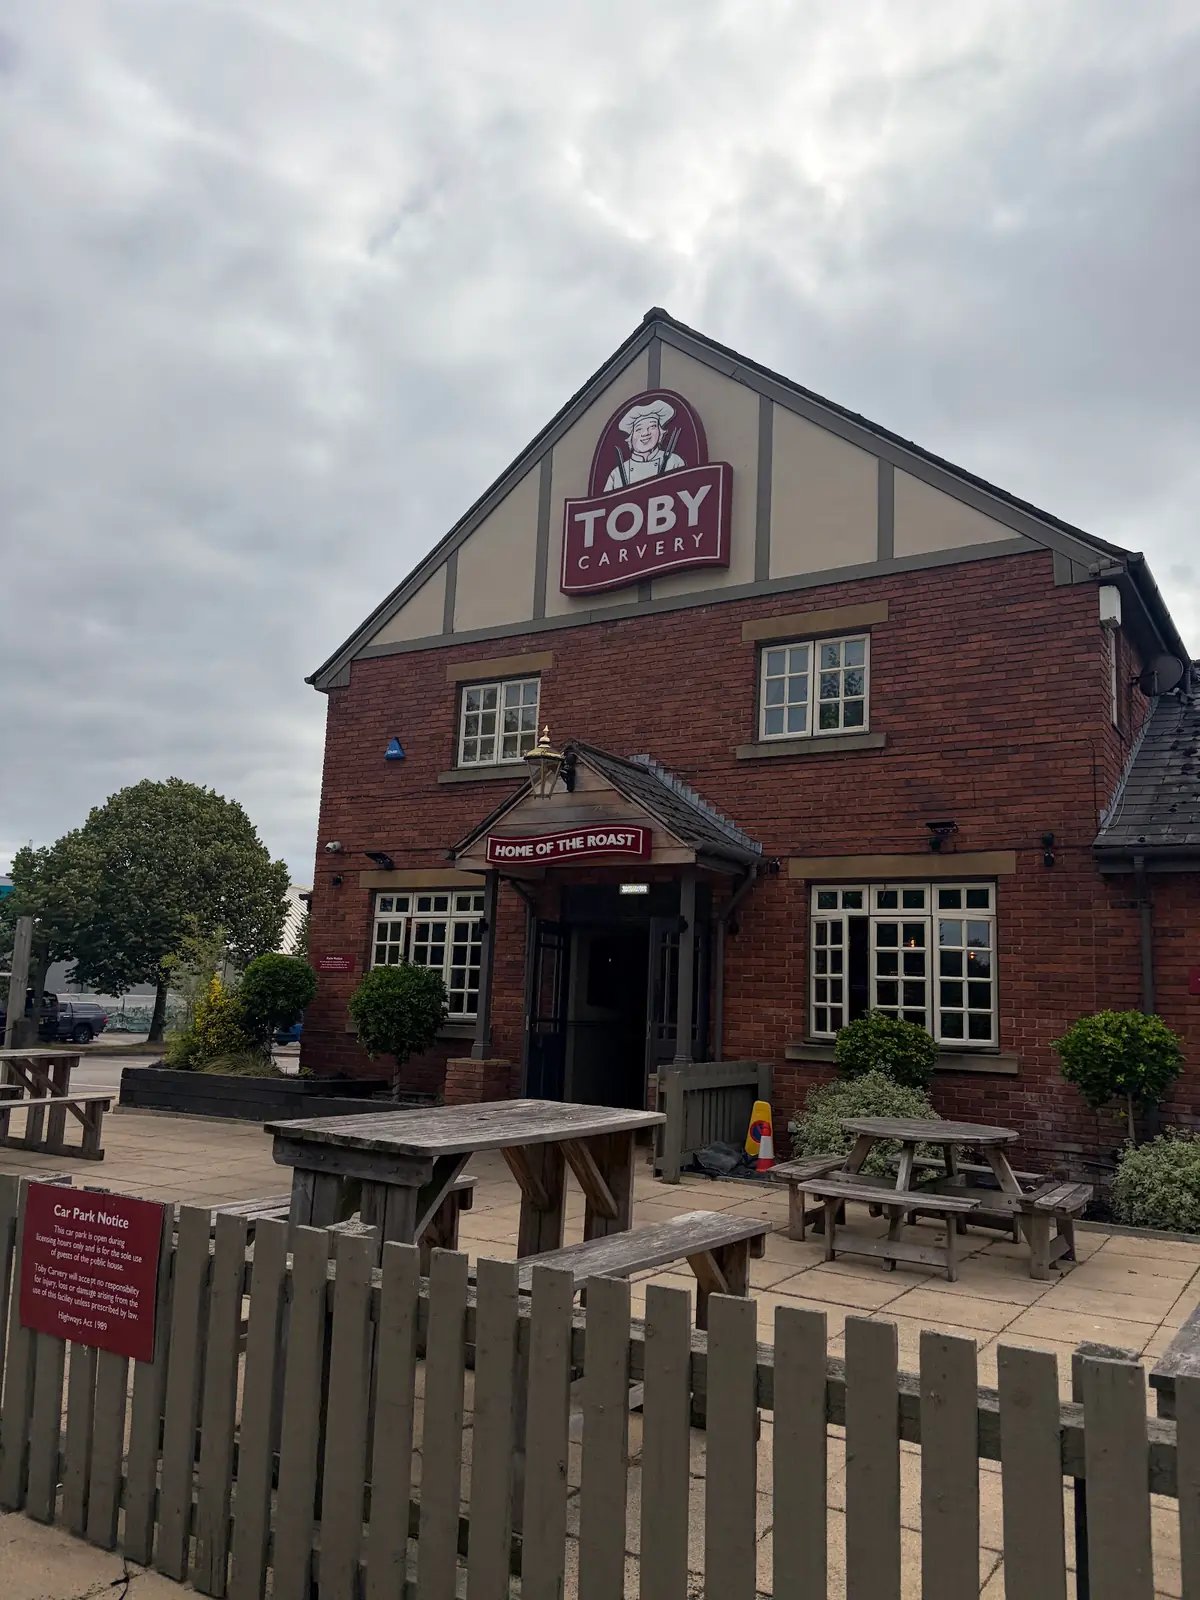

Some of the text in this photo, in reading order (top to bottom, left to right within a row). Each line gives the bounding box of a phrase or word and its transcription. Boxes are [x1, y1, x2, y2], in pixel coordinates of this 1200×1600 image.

[575, 485, 712, 548] TOBY
[578, 533, 703, 570] CARVERY
[495, 834, 636, 858] HOME OF THE ROAST
[54, 1204, 128, 1229] Car Park Notice
[36, 1233, 56, 1246] licensing
[57, 1238, 71, 1247] hours
[73, 1242, 84, 1252] only
[96, 1246, 100, 1254] is
[102, 1247, 110, 1255] for
[111, 1249, 120, 1258] the
[121, 1252, 131, 1261] sole
[54, 1225, 64, 1234] This
[75, 1230, 87, 1239] park
[94, 1235, 107, 1243] open
[108, 1236, 125, 1248] during
[57, 1251, 72, 1259] guests
[81, 1255, 89, 1263] the
[90, 1258, 106, 1267] public
[35, 1263, 46, 1274] Toby
[48, 1266, 67, 1279] Carvery
[79, 1276, 96, 1287] accept
[105, 1282, 139, 1297] responsibility
[58, 1280, 68, 1290] loss
[76, 1286, 96, 1298] damage
[98, 1291, 114, 1304] arising
[115, 1295, 128, 1304] from
[129, 1299, 138, 1307] the
[42, 1288, 48, 1296] of
[48, 1290, 56, 1299] this
[57, 1292, 73, 1304] facility
[74, 1298, 90, 1307] unless
[91, 1302, 119, 1315] prescribed
[120, 1308, 126, 1318] by
[128, 1311, 138, 1320] law.
[58, 1311, 108, 1330] Highways Act 1989
